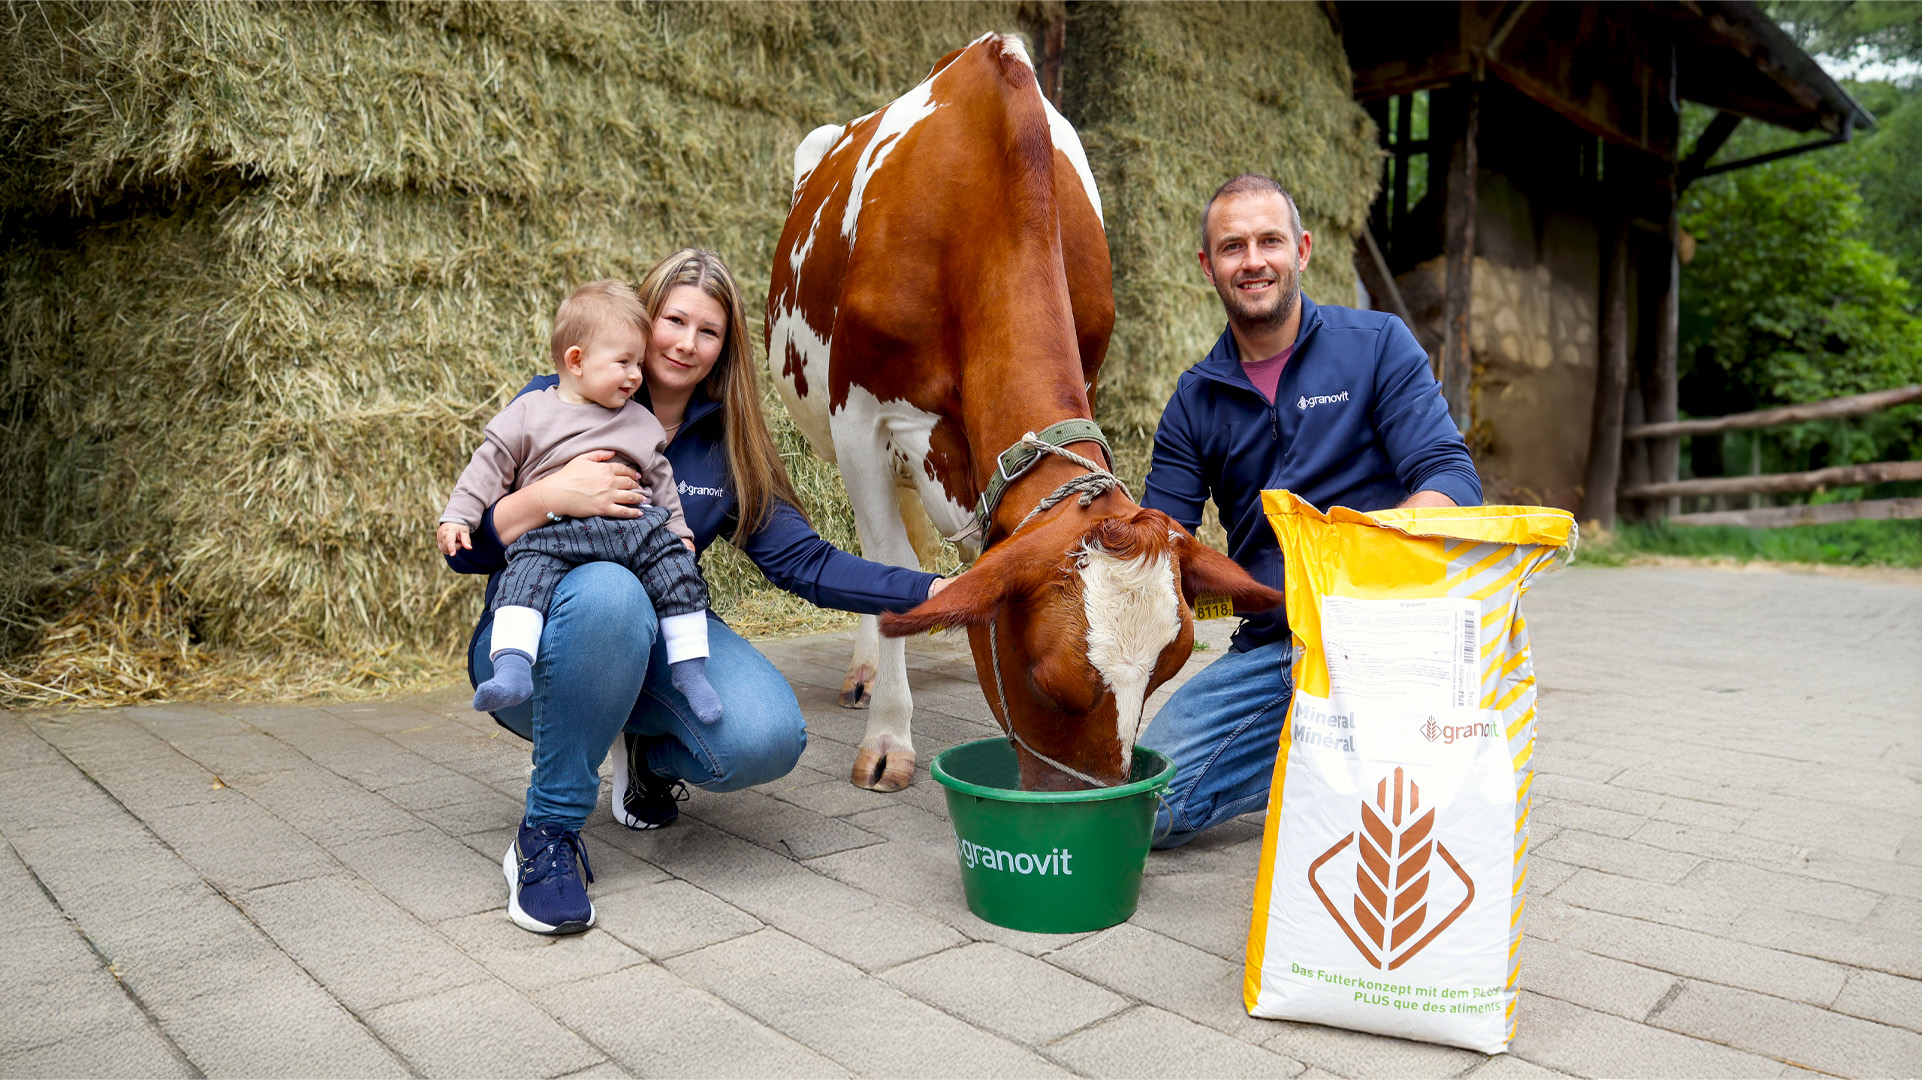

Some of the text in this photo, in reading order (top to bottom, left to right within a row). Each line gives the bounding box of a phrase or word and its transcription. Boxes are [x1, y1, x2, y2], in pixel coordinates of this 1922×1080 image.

[1308, 390, 1349, 408] granovit
[688, 485, 724, 498] granovit
[1197, 603, 1228, 619] 8118
[1295, 701, 1356, 729] Mineral
[1294, 723, 1355, 752] Minéral
[961, 838, 1073, 876] granovit
[1291, 962, 1501, 999] Das Futterkonzept mit dem PLUS
[1354, 991, 1501, 1014] PLUS que des aliments
